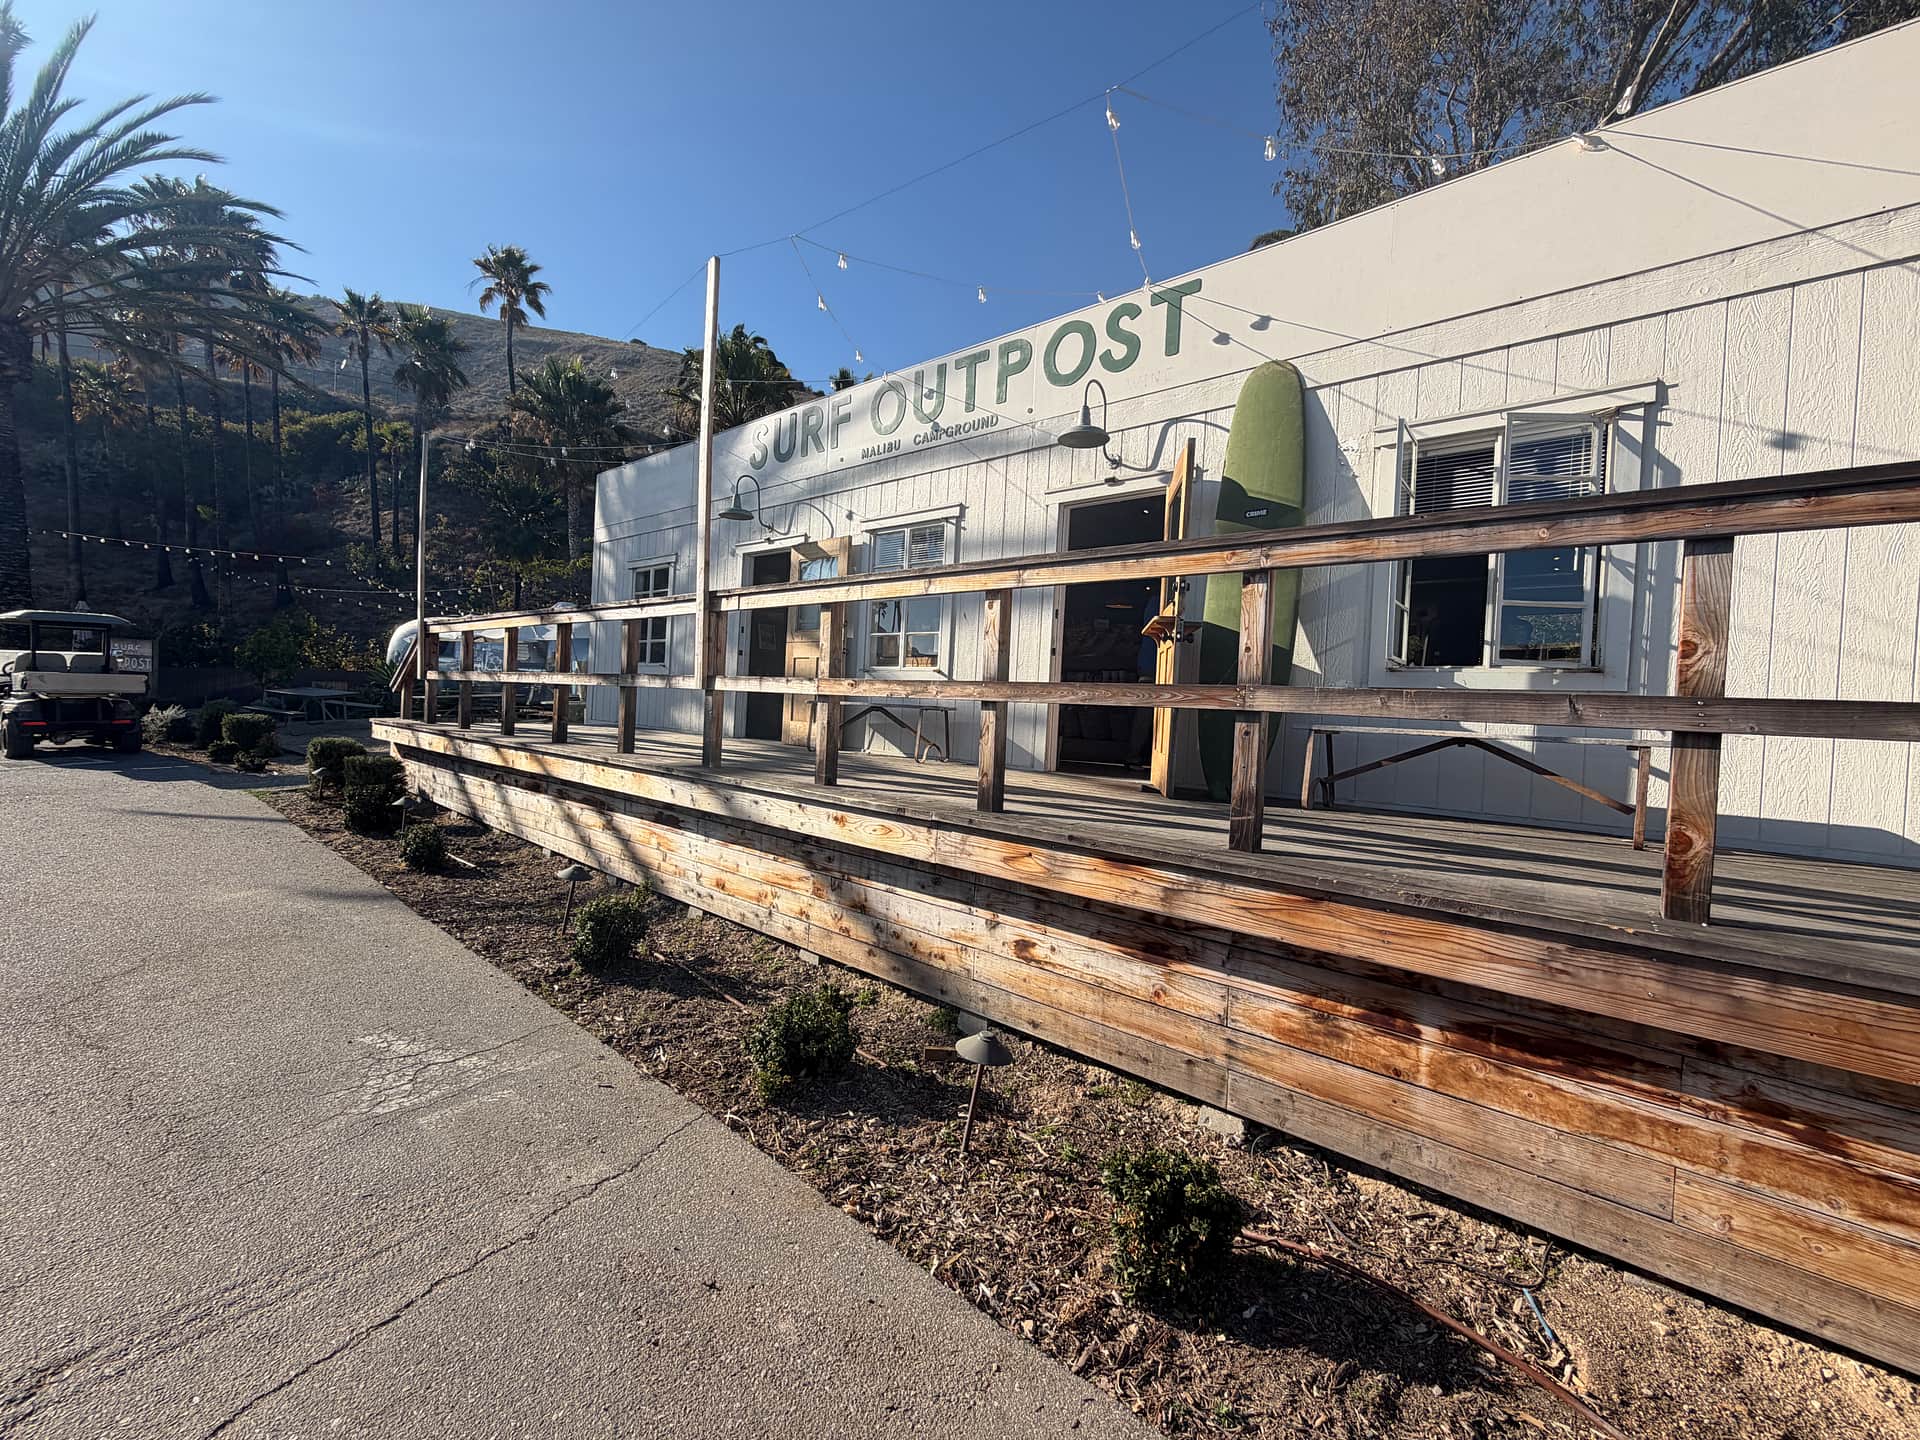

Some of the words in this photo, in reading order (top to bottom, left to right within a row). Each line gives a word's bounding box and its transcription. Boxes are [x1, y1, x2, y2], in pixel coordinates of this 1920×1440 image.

[750, 393, 852, 470] SURF
[870, 278, 1203, 436] OUTPOST
[861, 439, 901, 460] MALIBU
[913, 415, 999, 446] CAMPGROUND
[119, 657, 152, 670] POST
